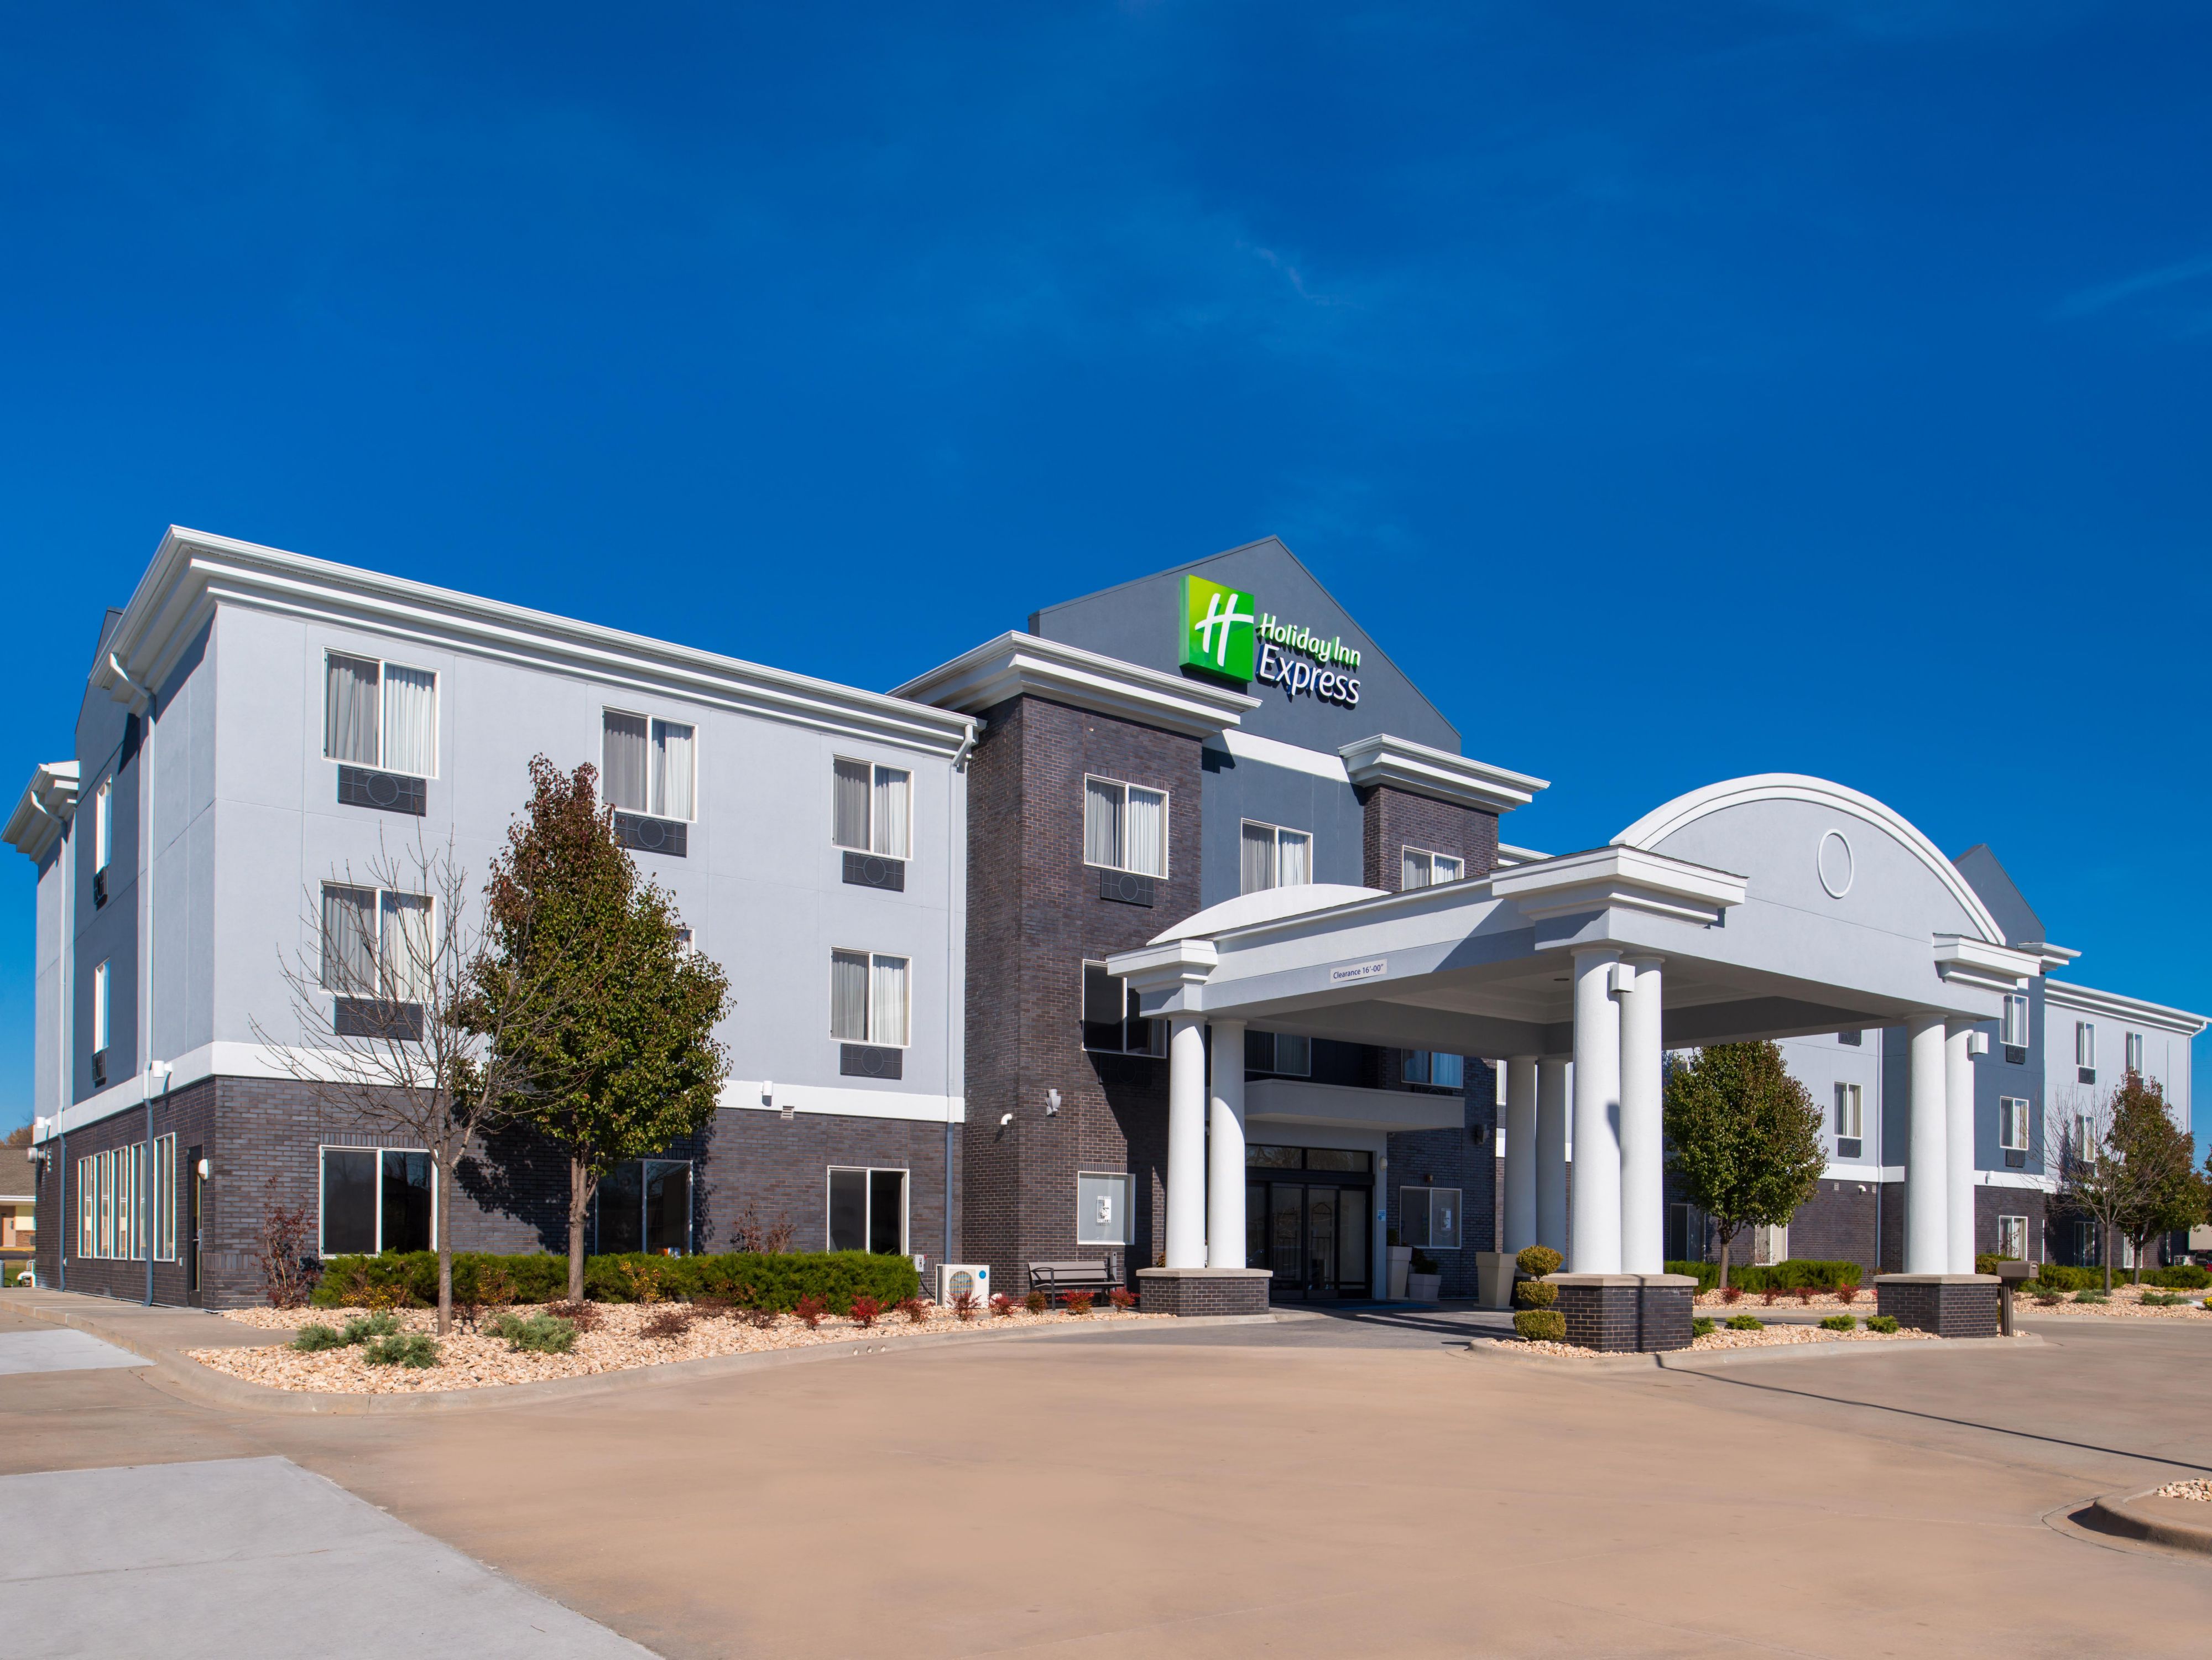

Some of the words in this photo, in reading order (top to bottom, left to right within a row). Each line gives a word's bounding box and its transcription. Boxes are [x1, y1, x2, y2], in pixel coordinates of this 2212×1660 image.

[1259, 612, 1332, 662] Holiday
[1333, 636, 1361, 667] Inn
[1259, 643, 1361, 704] Express
[1333, 969, 1361, 979] Clearance
